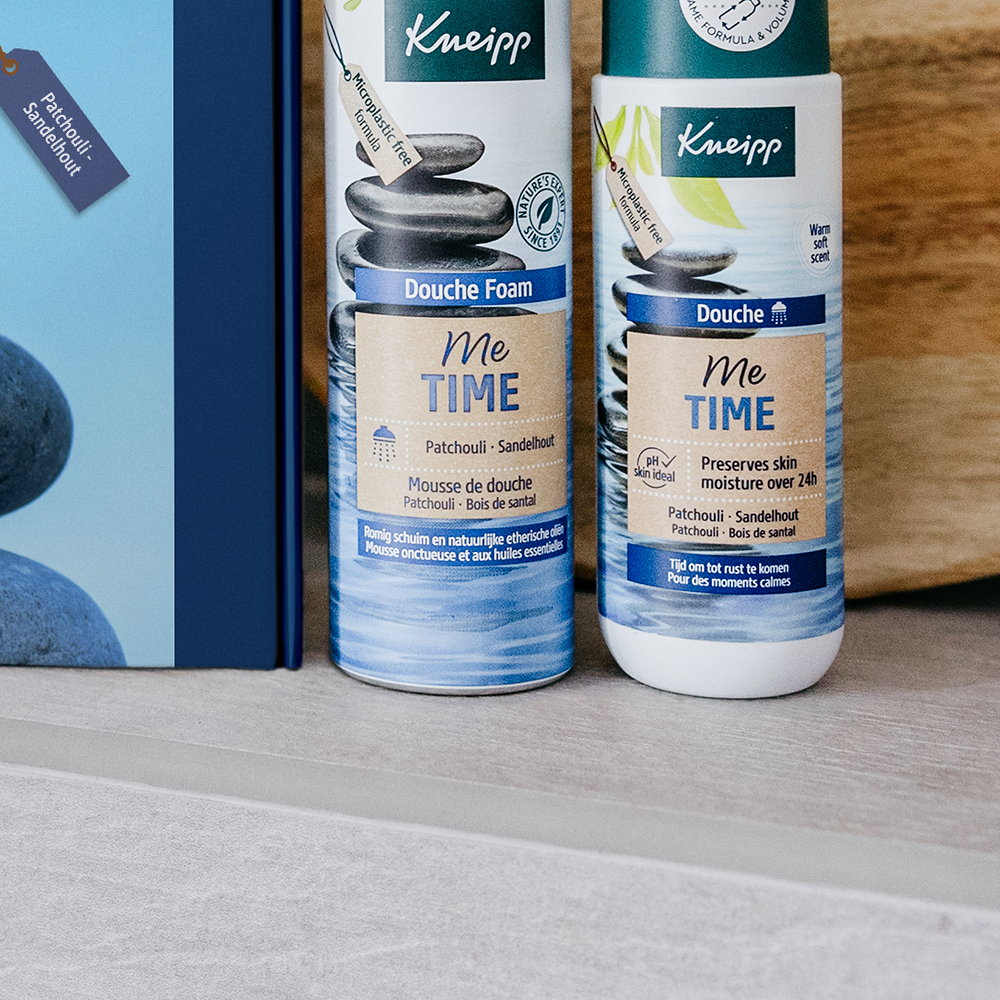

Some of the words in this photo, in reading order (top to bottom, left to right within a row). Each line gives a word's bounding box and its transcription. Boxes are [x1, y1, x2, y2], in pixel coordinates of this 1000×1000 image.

[405, 11, 531, 65] Kneipp
[701, 21, 755, 45] FORMULA
[757, 31, 765, 41] &
[40, 91, 92, 155] Patchouli
[352, 72, 396, 143] Microplastic
[391, 140, 412, 167] free
[354, 109, 381, 152] formula
[23, 102, 82, 177] Sandelhout
[677, 121, 782, 166] Kneipp
[519, 176, 549, 218] NATURE'S
[617, 167, 650, 224] Microplastic
[647, 221, 664, 245] free
[619, 195, 641, 233] formula
[524, 226, 547, 248] SINCE
[809, 223, 831, 236] Warm
[813, 236, 828, 250] soft
[810, 250, 831, 264] scent
[405, 278, 479, 300] Douche
[485, 279, 533, 300] Foam
[697, 303, 764, 323] Douche
[441, 331, 510, 366] Me
[703, 354, 767, 388] Me
[421, 372, 519, 413] TIME
[684, 394, 775, 431] TIME
[426, 440, 487, 454] Patchouli
[498, 434, 555, 453] Sandelhout
[646, 455, 659, 467] pH
[701, 456, 769, 472] Preserves
[773, 455, 797, 471] skin
[408, 477, 461, 494] Mousse
[466, 477, 482, 494] de
[487, 476, 533, 493] douche
[634, 466, 651, 479] skin
[653, 468, 675, 482] ideal
[701, 476, 763, 491] moisture
[767, 477, 794, 490] over
[798, 471, 817, 488] 24h
[404, 496, 455, 510] Patchouli
[466, 499, 490, 510] Bois
[493, 498, 506, 510] de
[508, 494, 536, 509] santal
[668, 506, 724, 523] Patchouli
[735, 508, 799, 523] Sandelhout
[364, 525, 391, 544] Romig
[393, 531, 430, 546] schuim
[432, 536, 446, 546] en
[448, 533, 504, 549] natuurlijke
[506, 528, 549, 545] etherische
[672, 524, 719, 538] Patchouli
[729, 527, 751, 539] Bois
[754, 527, 766, 539] de
[768, 525, 796, 538] santal
[365, 540, 400, 558] Mousse
[401, 548, 456, 561] onctueuse
[458, 550, 470, 561] et
[472, 551, 492, 561] aux
[494, 547, 522, 560] huiles
[524, 539, 564, 558] essentielles
[670, 558, 687, 573] Tijd
[688, 562, 705, 572] om
[707, 561, 722, 574] tot
[724, 563, 745, 575] rust
[748, 564, 757, 575] te
[758, 562, 789, 574] komen
[667, 572, 689, 585] Pour
[691, 574, 710, 587] des
[711, 577, 758, 588] moments
[760, 575, 791, 587] calmes
